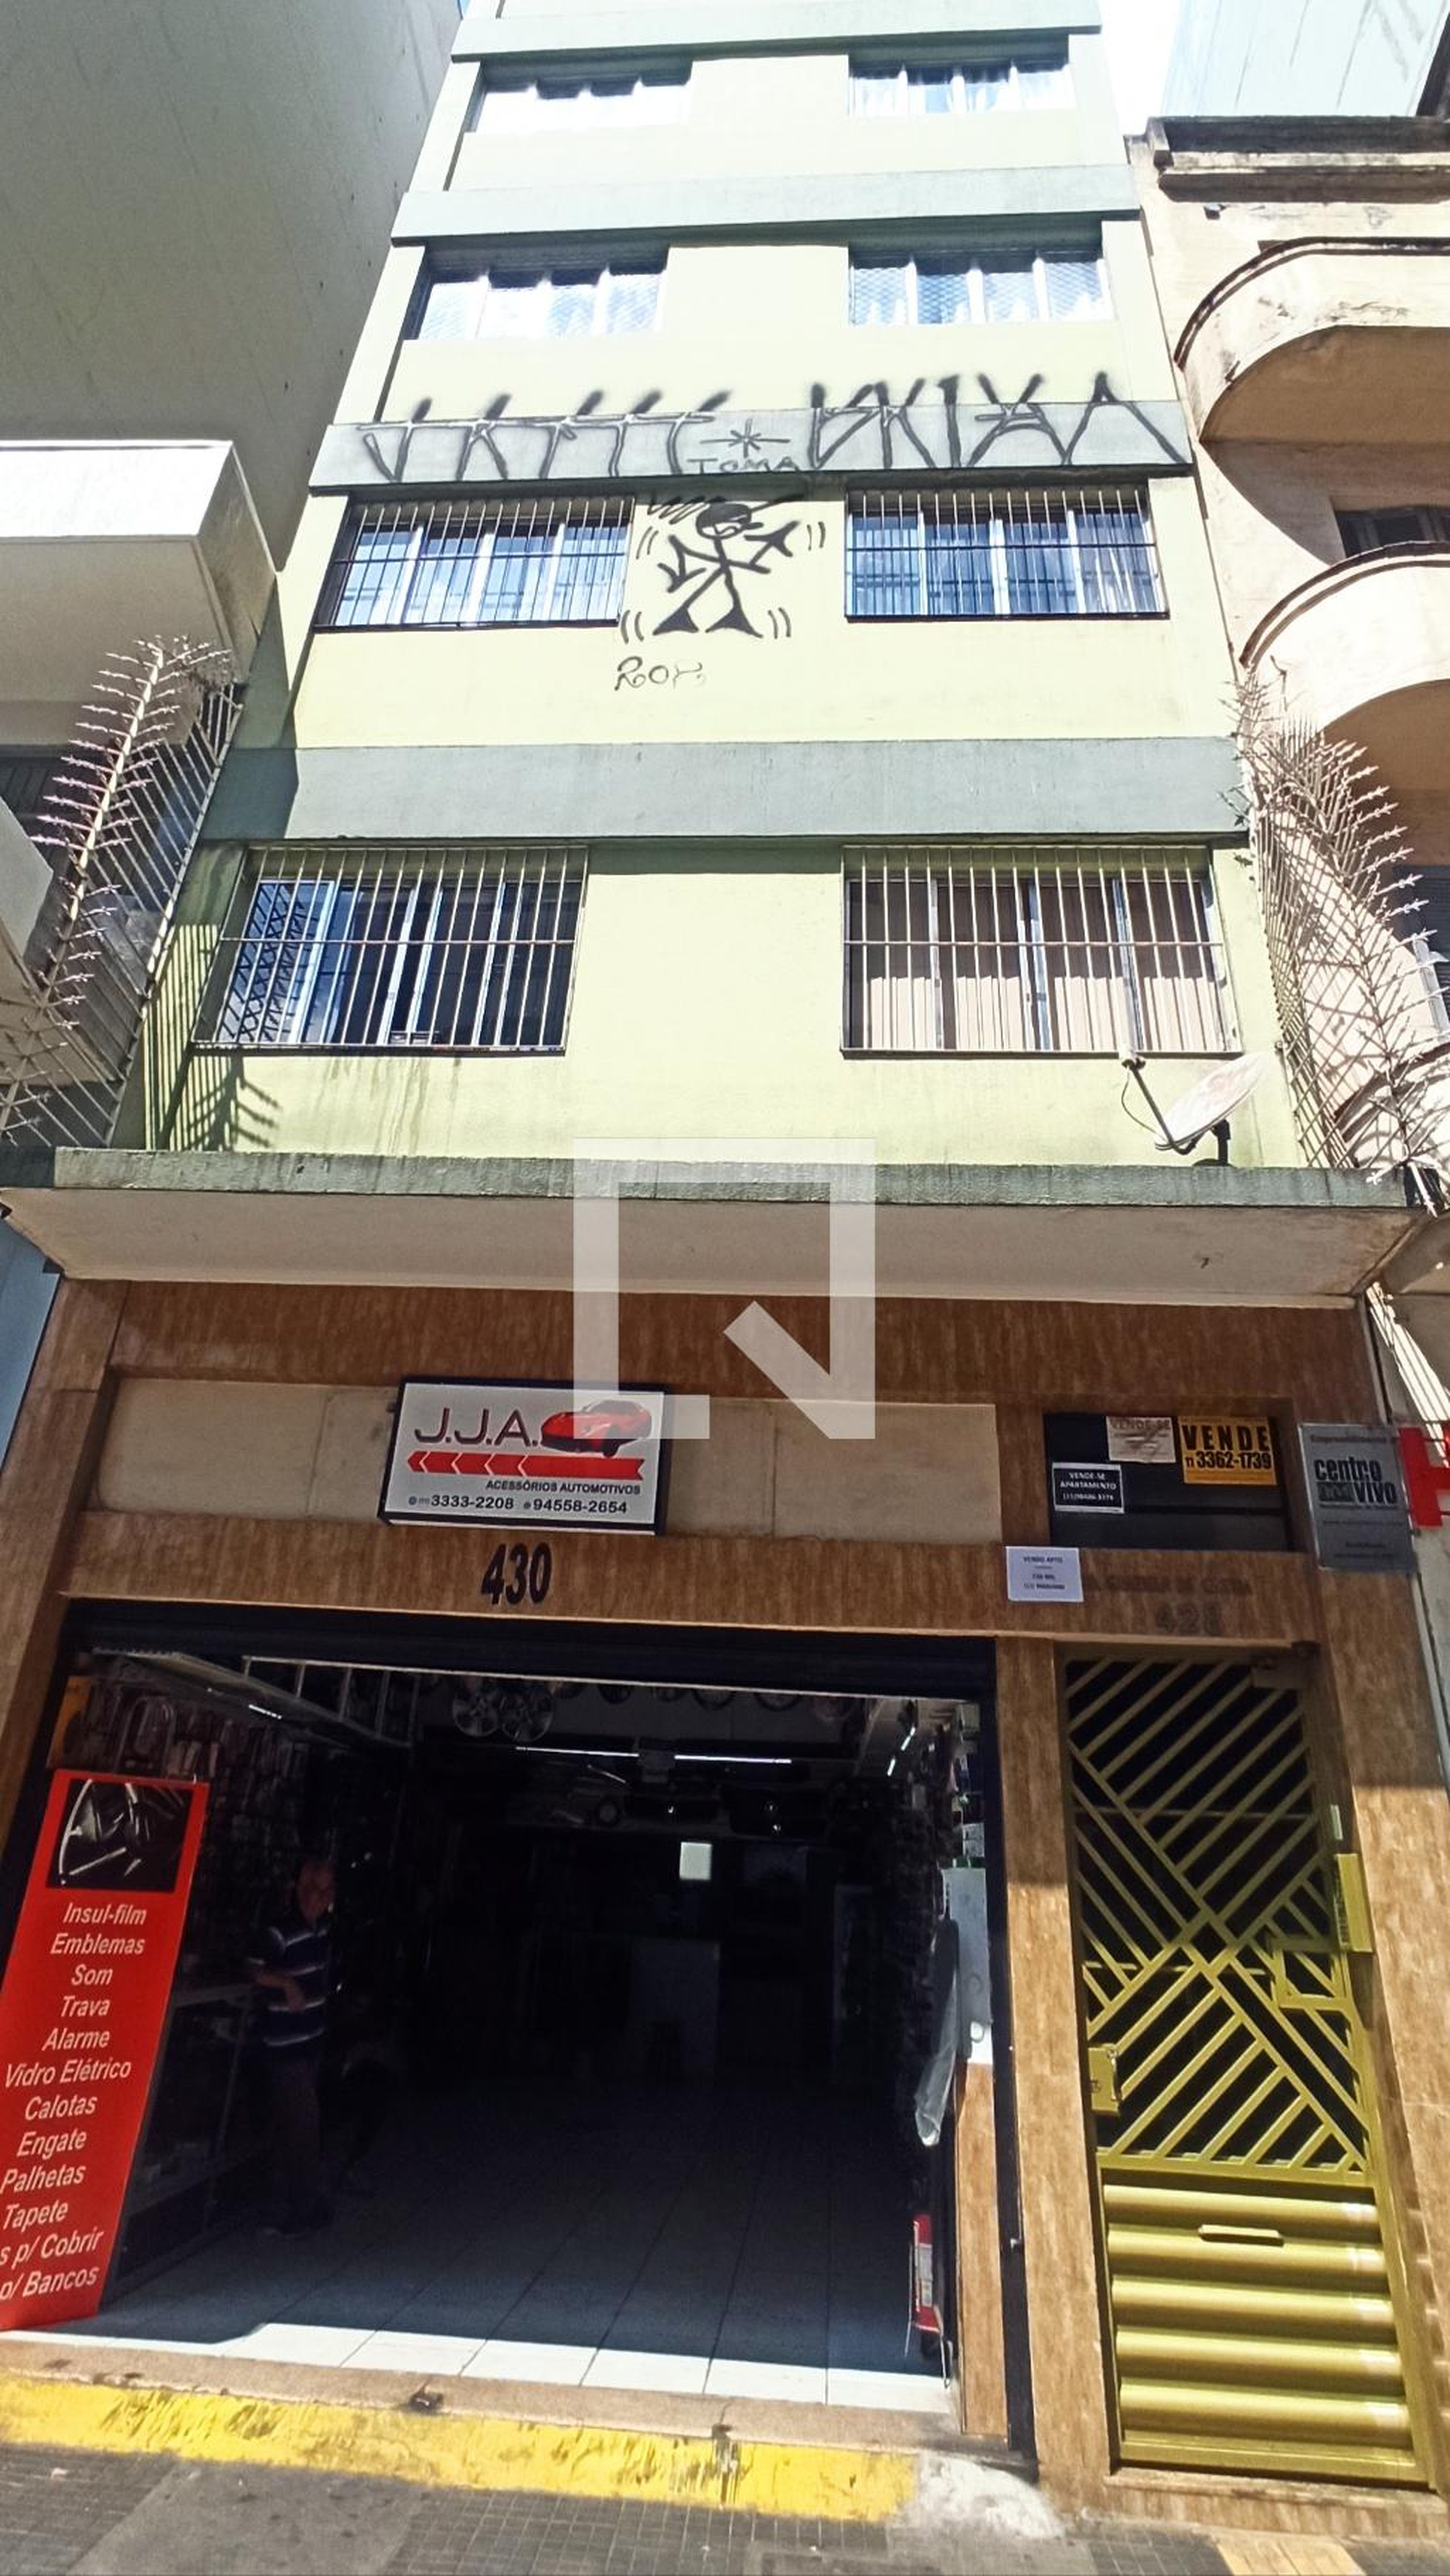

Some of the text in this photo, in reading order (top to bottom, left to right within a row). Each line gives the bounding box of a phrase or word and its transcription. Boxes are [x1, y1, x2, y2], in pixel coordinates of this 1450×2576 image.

[414, 1407, 538, 1447] J.J.A.
[1182, 1425, 1270, 1451] VENDE
[1196, 1451, 1272, 1469] 3362-1739
[1314, 1456, 1382, 1482] centro
[486, 1479, 641, 1495] ACESSÓRIOS AUTOMOTIVOS
[431, 1494, 514, 1509] 3333-2208
[533, 1497, 627, 1513] 94558-2654
[481, 1542, 552, 1606] 430
[63, 1903, 147, 1925] Insul-film
[50, 1932, 146, 1954] Emblemas
[71, 1963, 113, 1985] Som
[60, 1996, 111, 2017] Trava
[42, 2027, 110, 2051] Alarme
[5, 2057, 132, 2088] Vidro Elétrico
[25, 2094, 98, 2120] Calotas
[16, 2128, 87, 2160] Engate
[0, 2164, 86, 2194] Palhetas
[3, 2199, 69, 2232] Tapete
[11, 2235, 40, 2270] p/
[40, 2226, 104, 2259] Cobrir
[22, 2266, 99, 2298] Bancos
